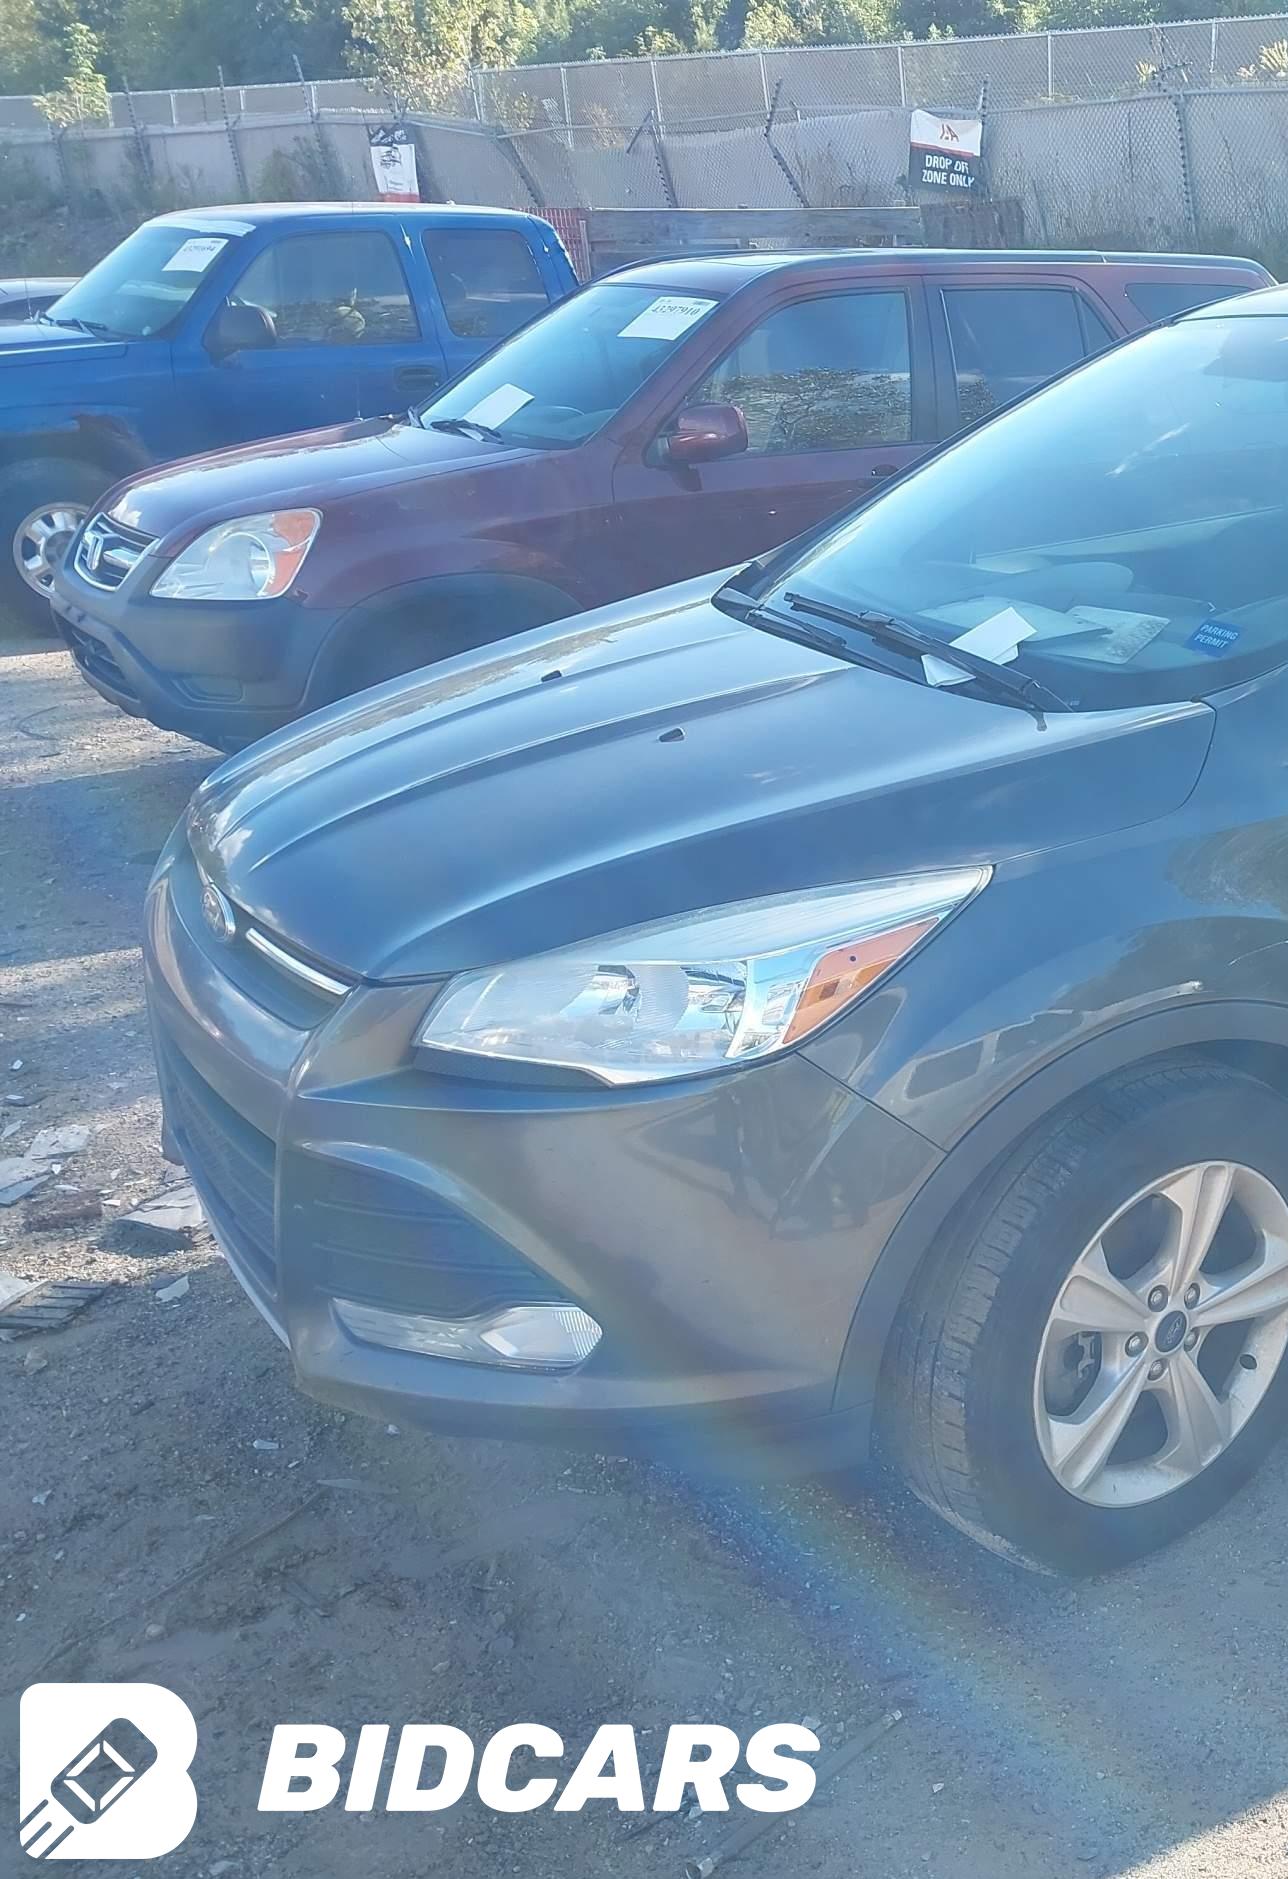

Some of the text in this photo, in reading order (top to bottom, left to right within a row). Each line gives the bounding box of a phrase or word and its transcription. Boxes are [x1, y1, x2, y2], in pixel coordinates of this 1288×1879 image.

[925, 154, 951, 170] DROP
[922, 169, 975, 188] ZONE ONLY
[1200, 624, 1239, 640] PARKING
[1194, 633, 1229, 649] PERMIT
